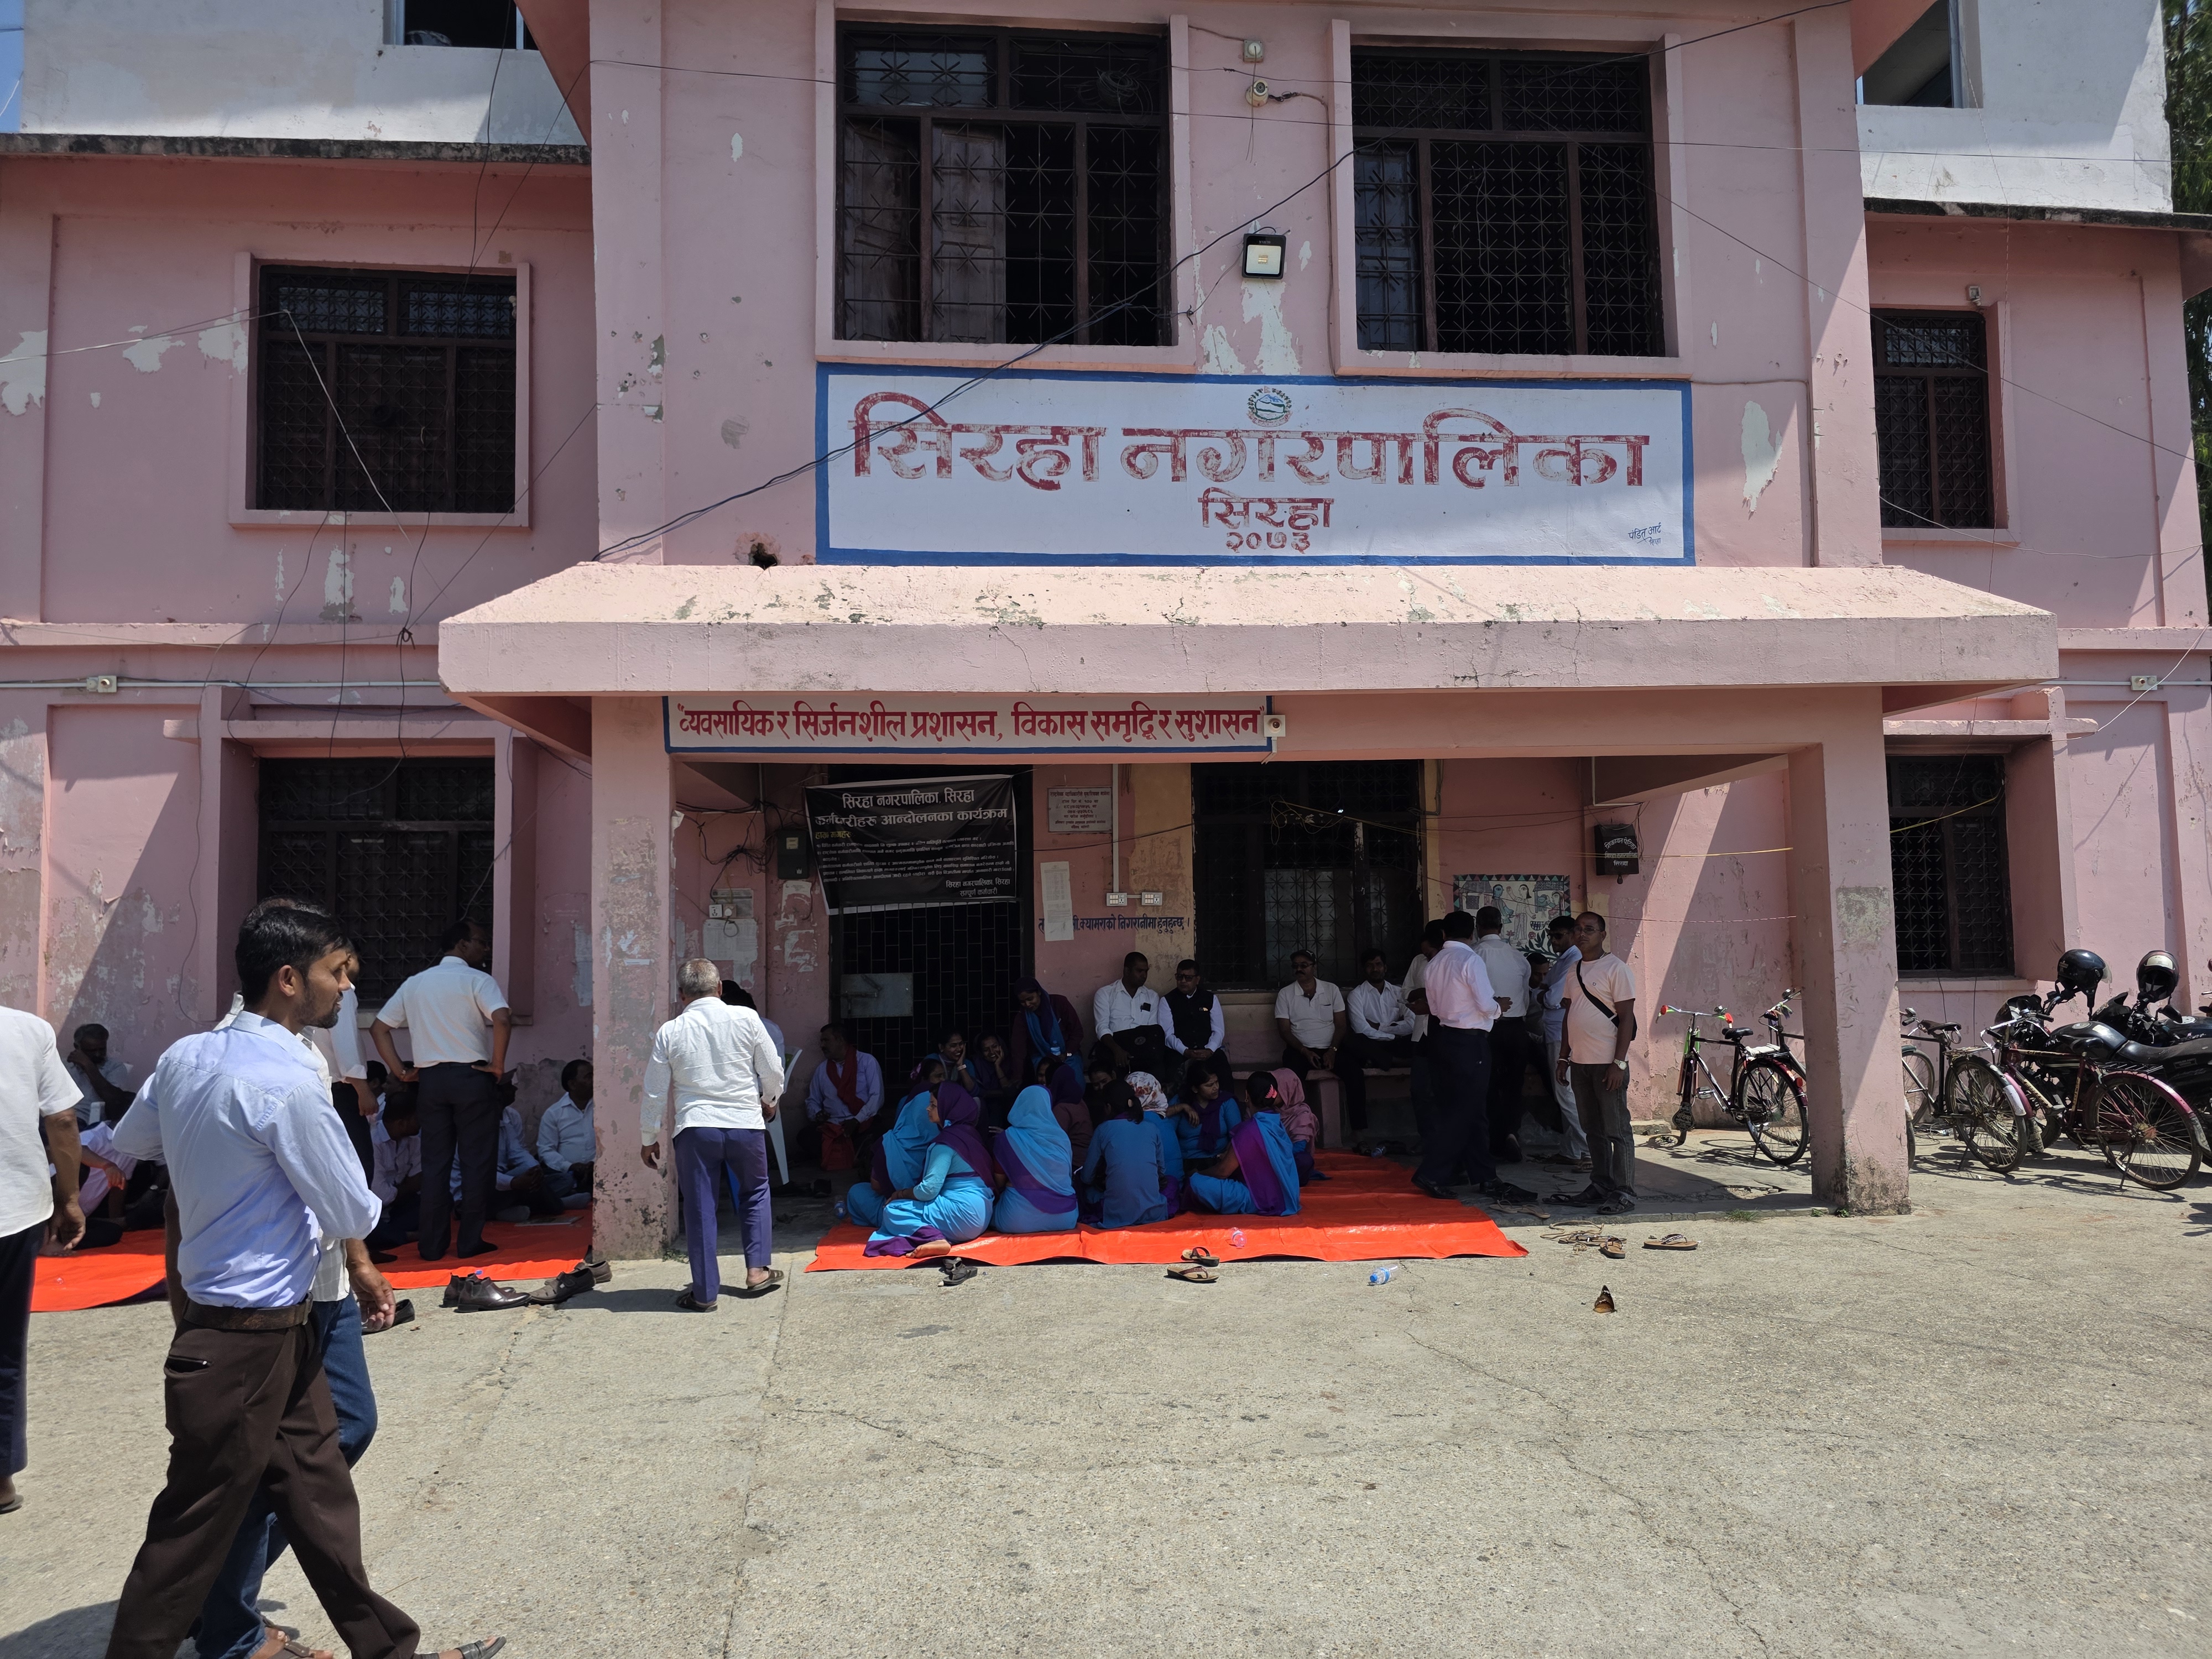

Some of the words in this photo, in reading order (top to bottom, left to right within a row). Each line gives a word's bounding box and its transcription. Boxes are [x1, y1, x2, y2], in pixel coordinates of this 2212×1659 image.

[847, 390, 1107, 490] सिरहा
[1120, 408, 1650, 488] नगरपालिका
[1198, 487, 1334, 530] सिरहा
[1647, 522, 1662, 535] आर्ट
[1226, 532, 1311, 554] २०७३
[776, 711, 790, 740] र
[792, 700, 907, 742] सिर्जनशील
[910, 711, 1003, 742] प्रशासन,
[1011, 701, 1088, 741] विकास
[1158, 710, 1173, 740] र
[842, 793, 874, 809] सिरहा
[876, 789, 941, 807] नगरपालिका,
[944, 787, 975, 804] सिरहा
[880, 810, 954, 825] आन्दोलनका
[957, 807, 1008, 821] कार्यक्रम
[946, 880, 961, 889] सिरहा
[995, 877, 1010, 885] सिरहा
[1118, 913, 1157, 931] निगरानीमा
[1157, 917, 1185, 934] हुनुहुन्छ
